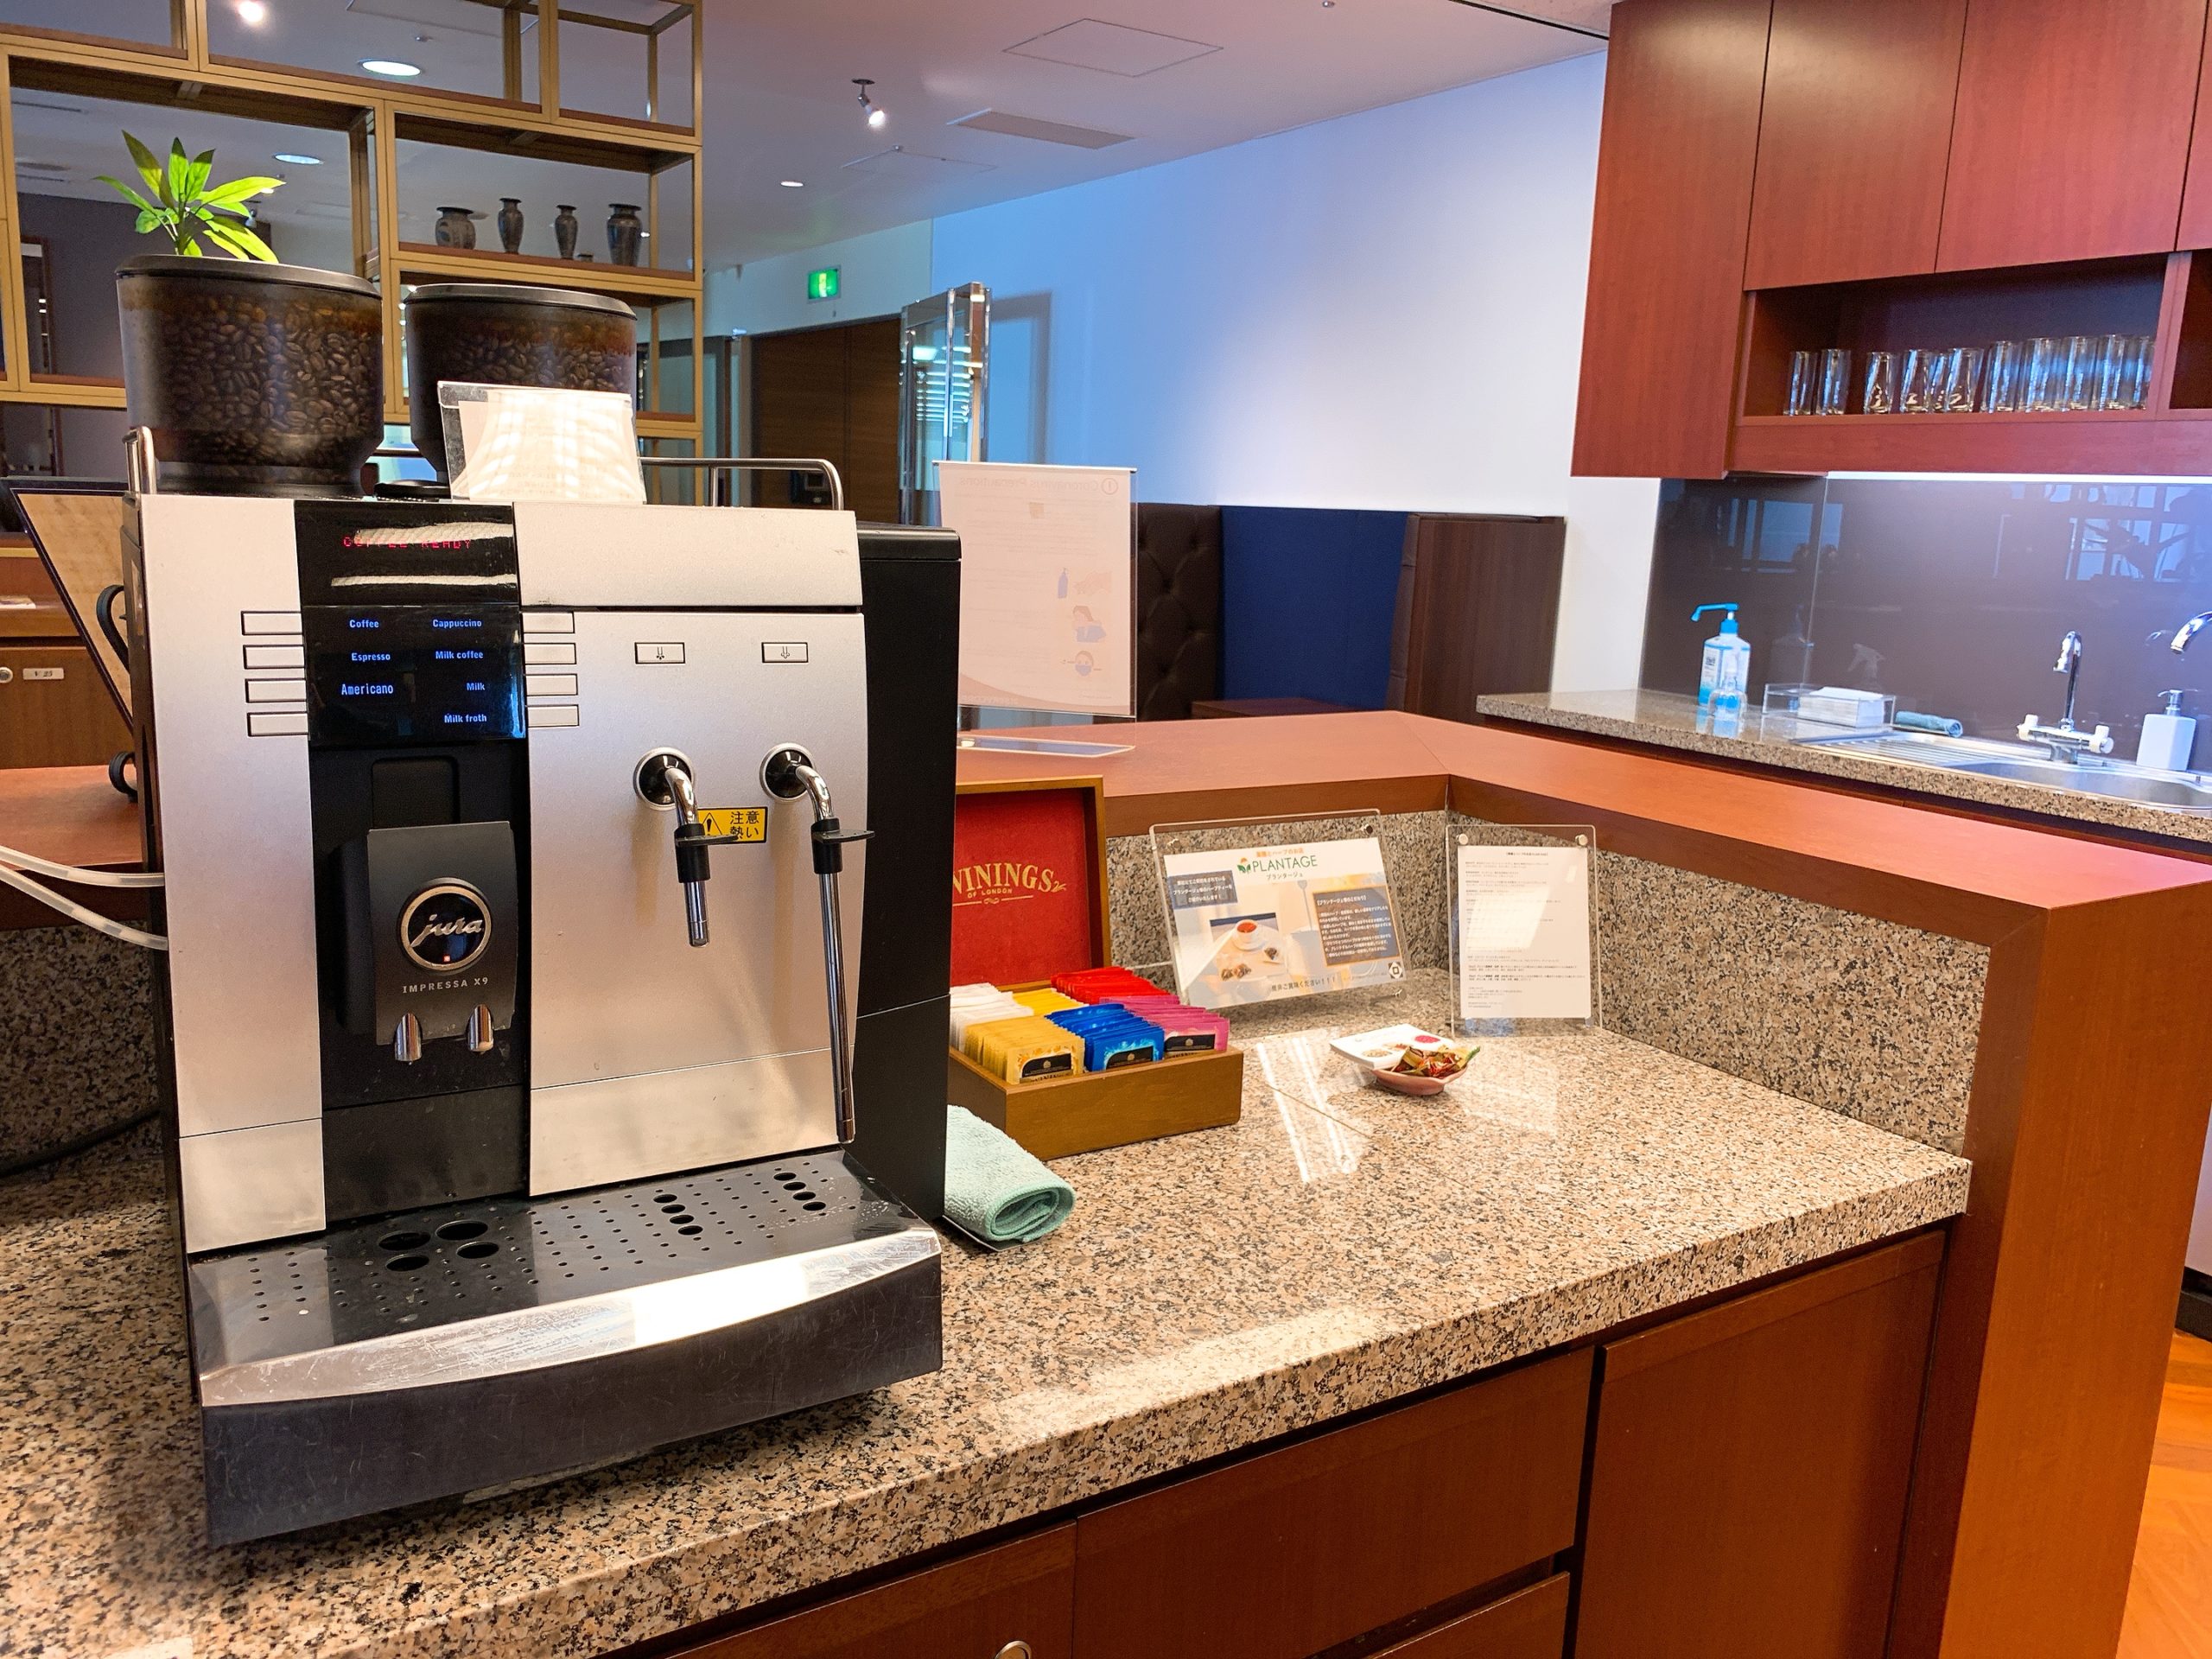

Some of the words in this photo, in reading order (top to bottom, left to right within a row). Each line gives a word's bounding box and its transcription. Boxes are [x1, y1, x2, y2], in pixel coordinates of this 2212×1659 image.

[349, 619, 380, 629] Coffee
[432, 619, 482, 629] Cappuccino
[351, 652, 391, 663] Espresso
[435, 650, 454, 660] Milk
[456, 650, 484, 659] coffee
[340, 683, 394, 696] Americano
[466, 682, 486, 692] Milk
[443, 713, 464, 724] Milk
[465, 713, 487, 723] froth
[729, 810, 760, 825] 注意
[1252, 855, 1319, 873] PLANTAGE
[953, 862, 1055, 894] ININGS
[981, 887, 1014, 896] LONDON
[410, 914, 485, 948] jura
[402, 979, 468, 994] IMPRESSA
[474, 977, 489, 987] X9
